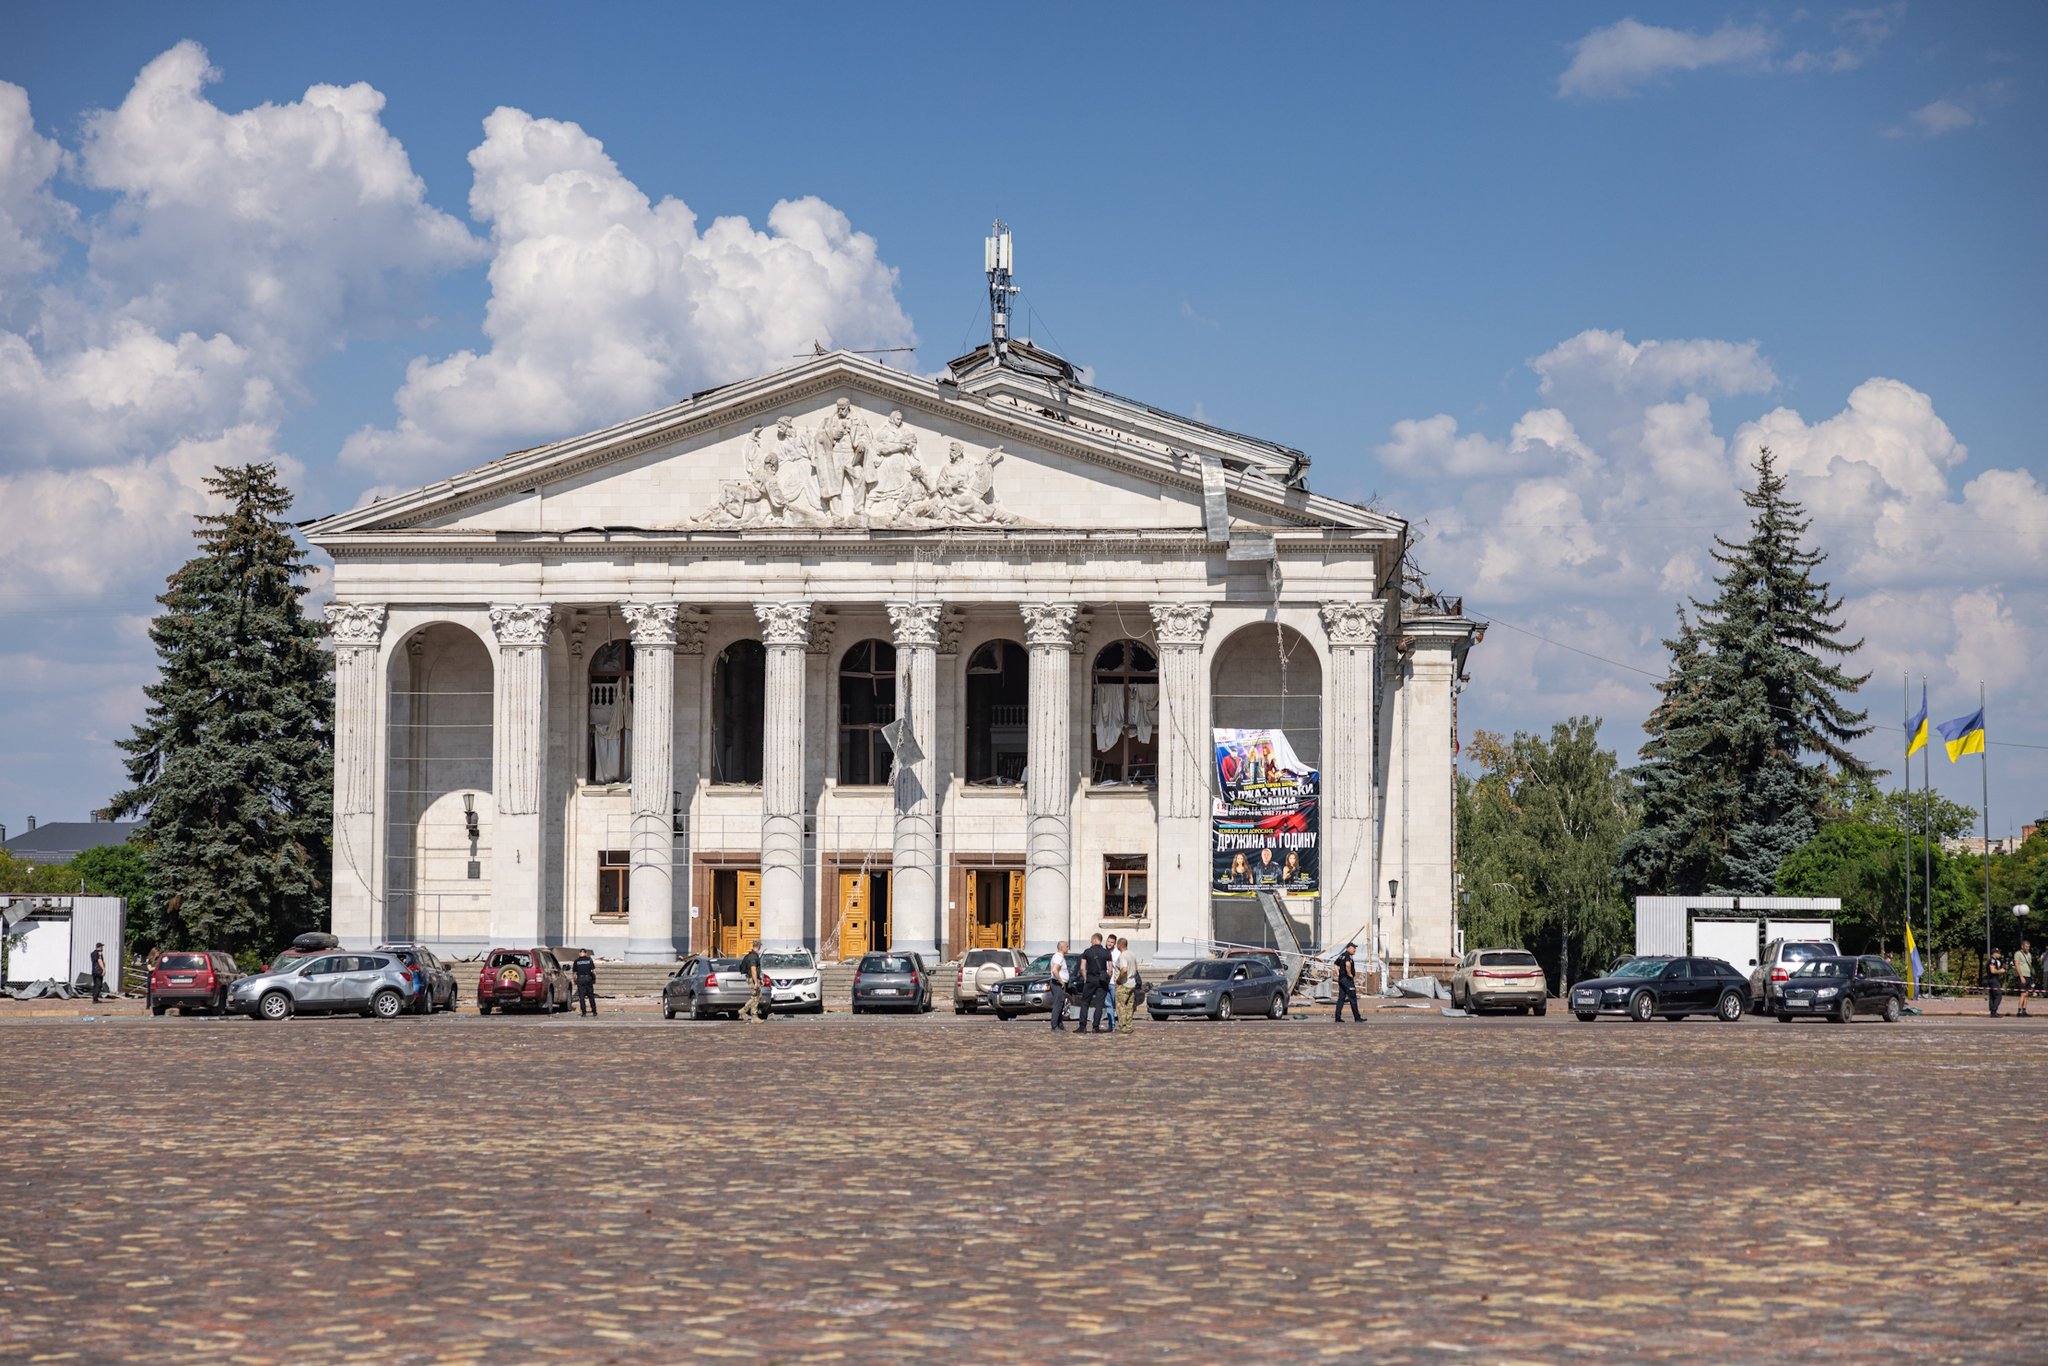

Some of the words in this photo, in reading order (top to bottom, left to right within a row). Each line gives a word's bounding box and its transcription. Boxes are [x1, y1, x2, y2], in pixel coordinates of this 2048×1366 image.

[1217, 833, 1265, 852] ДРУЖИНА
[1267, 837, 1277, 849] НА
[1278, 832, 1317, 851] ГОДИНУ
